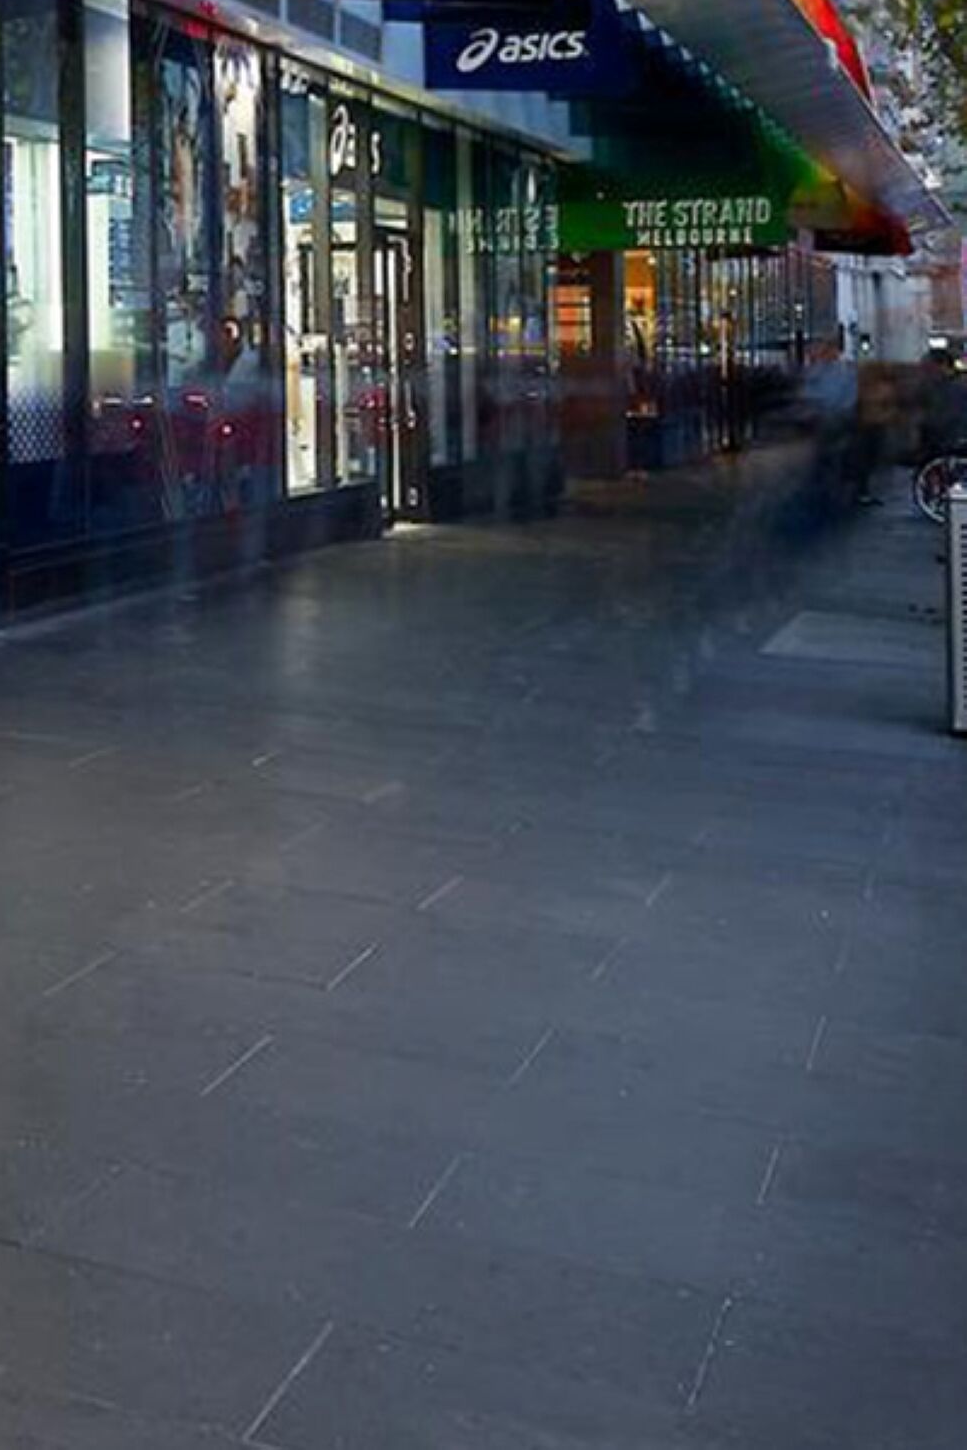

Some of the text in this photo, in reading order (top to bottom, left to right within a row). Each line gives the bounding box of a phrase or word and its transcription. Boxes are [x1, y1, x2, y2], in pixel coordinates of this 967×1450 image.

[497, 31, 586, 63] asics
[623, 197, 772, 227] THE STRAND
